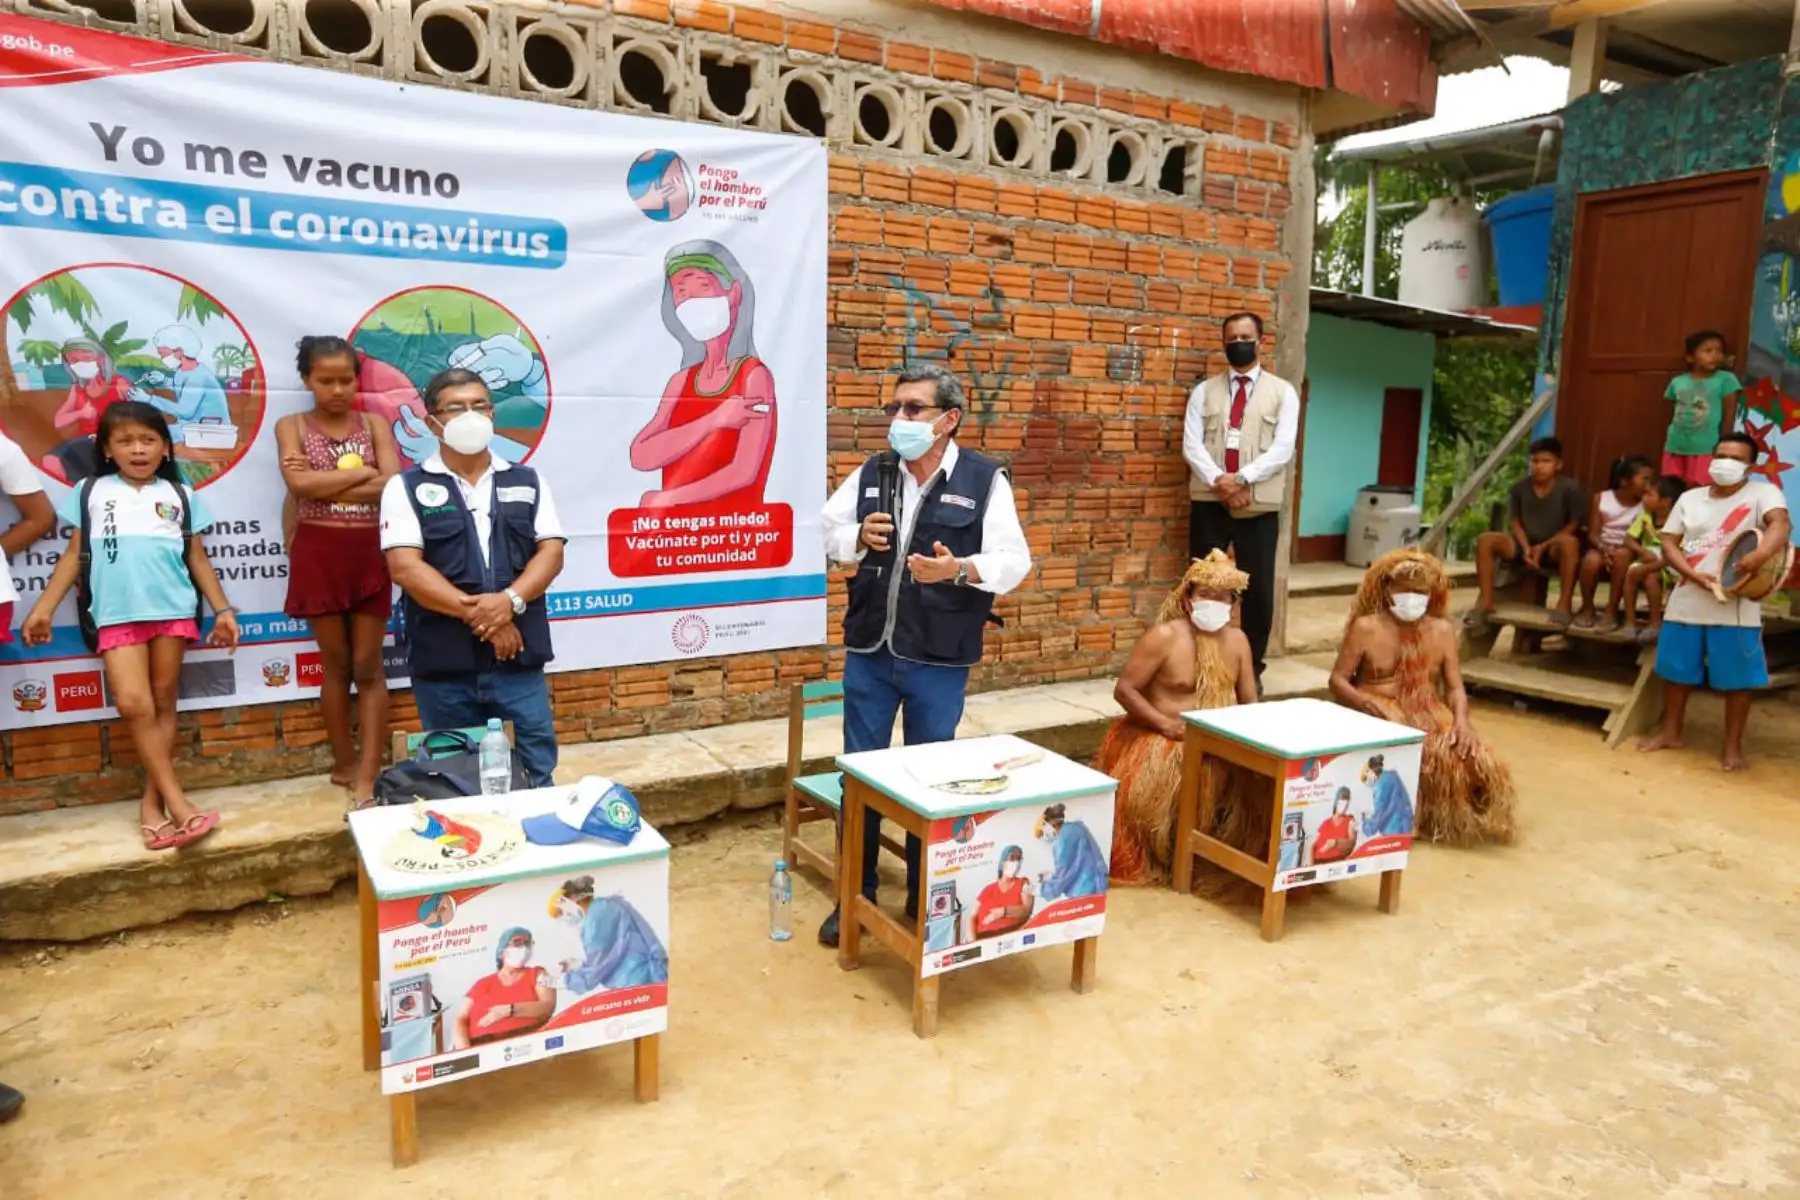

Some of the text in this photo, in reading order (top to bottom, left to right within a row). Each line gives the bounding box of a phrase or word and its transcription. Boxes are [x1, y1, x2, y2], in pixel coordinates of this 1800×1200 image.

[89, 122, 460, 199] Yo me vacuno
[699, 163, 739, 181] Pongo
[700, 179, 762, 196] el hombro
[699, 194, 768, 210] por el Perú
[0, 178, 550, 260] contra el coronavirus
[201, 520, 261, 535] onas
[632, 511, 769, 533] ¡No tengas miedo!
[204, 538, 288, 558] unadas
[625, 530, 780, 551] Vacúnate por ti y por
[656, 549, 757, 568] tu comunidad
[213, 563, 288, 580] avirus
[554, 594, 634, 612] 113 SALUD
[269, 616, 308, 633] más
[301, 664, 326, 675] PER
[60, 684, 98, 698] PERÚ
[393, 923, 488, 949] Pongo el hombro
[410, 945, 431, 959] por
[432, 941, 443, 951] el
[445, 936, 471, 948] Perú
